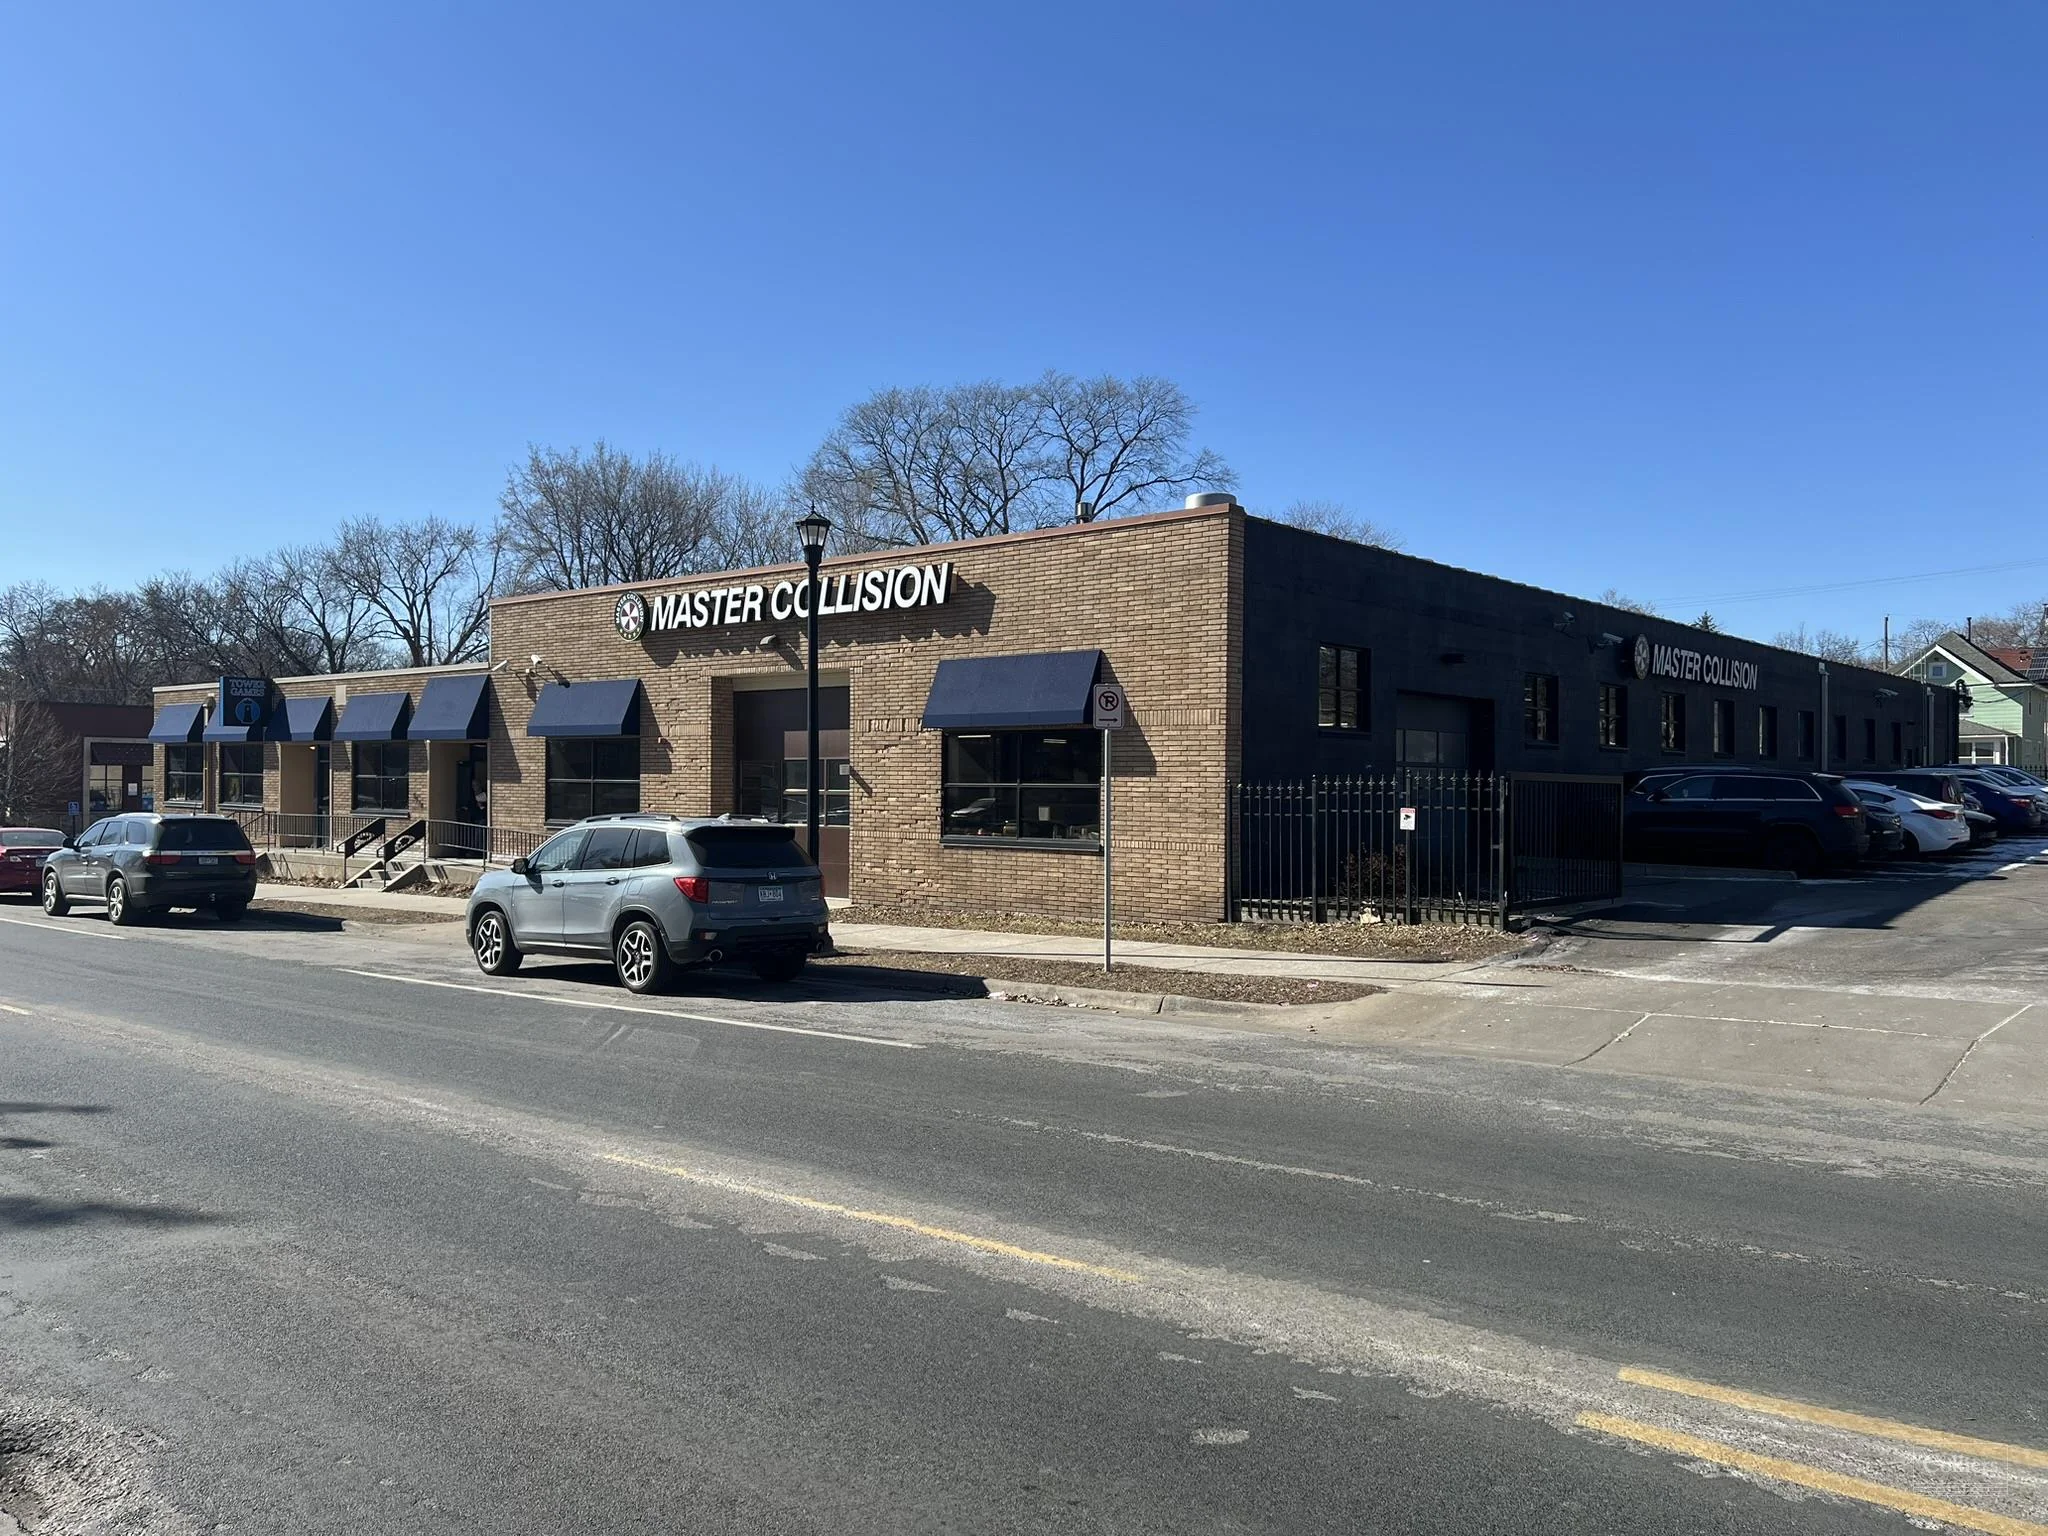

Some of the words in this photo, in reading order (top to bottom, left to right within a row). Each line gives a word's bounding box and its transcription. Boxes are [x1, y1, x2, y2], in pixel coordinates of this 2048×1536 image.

[651, 587, 762, 631] MASTER
[771, 562, 949, 621] COLLISION
[1652, 644, 1701, 681] MASTER
[1703, 654, 1758, 690] COLLISION
